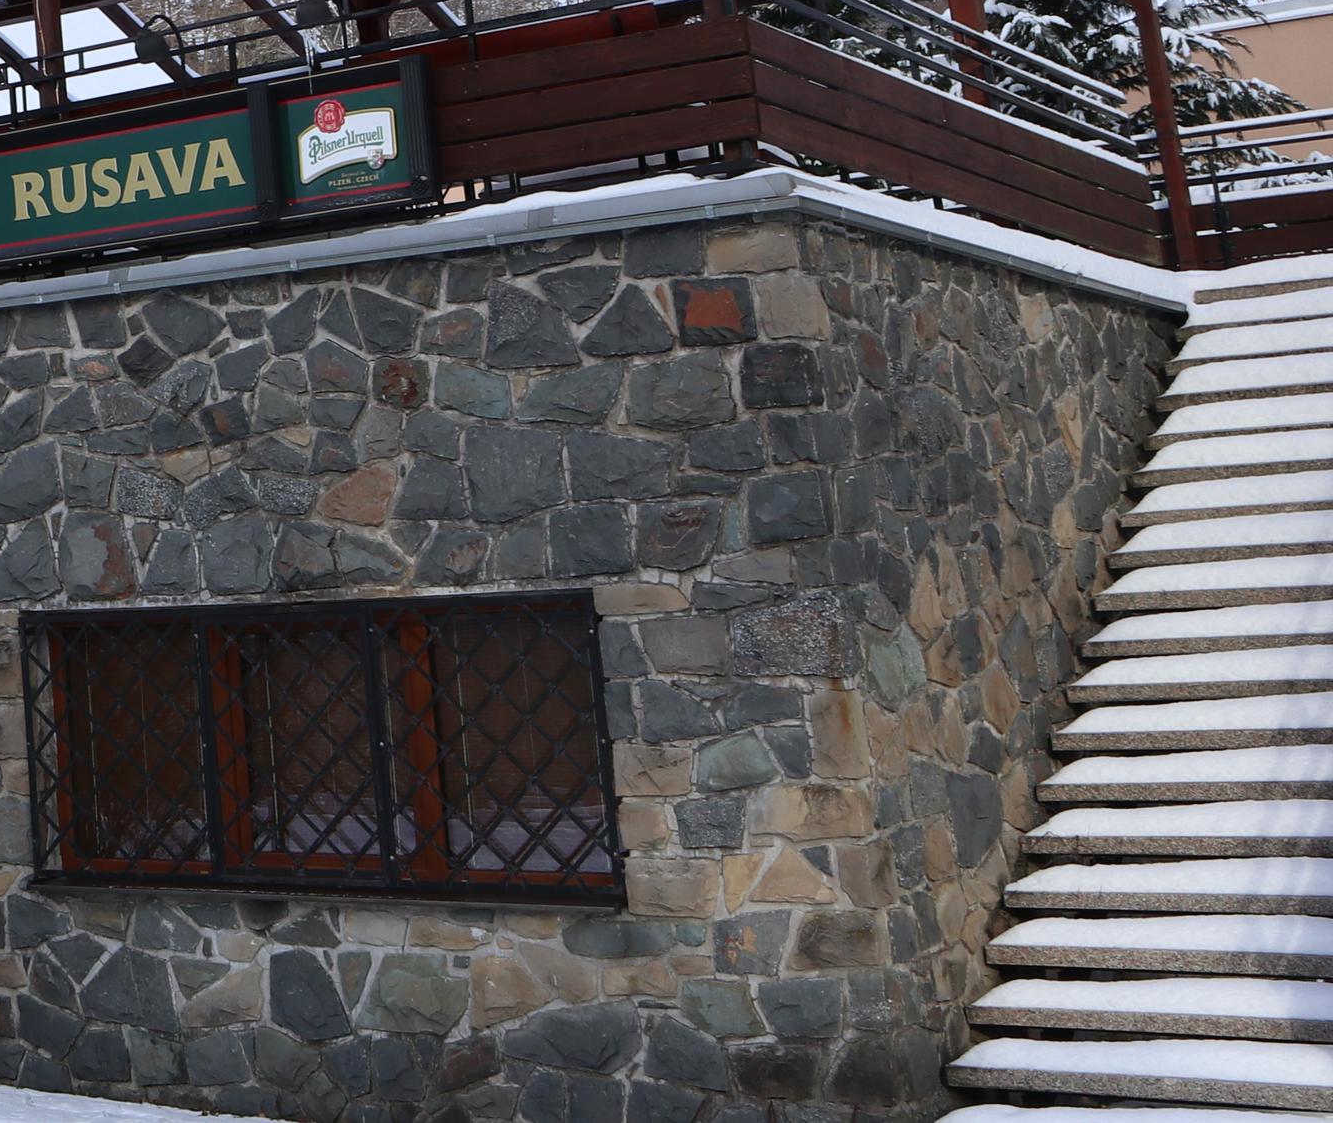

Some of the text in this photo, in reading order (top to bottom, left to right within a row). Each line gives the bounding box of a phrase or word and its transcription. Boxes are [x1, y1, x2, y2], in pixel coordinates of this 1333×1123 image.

[309, 126, 384, 165] Pilsner Urquell
[11, 138, 246, 222] RUSAVA
